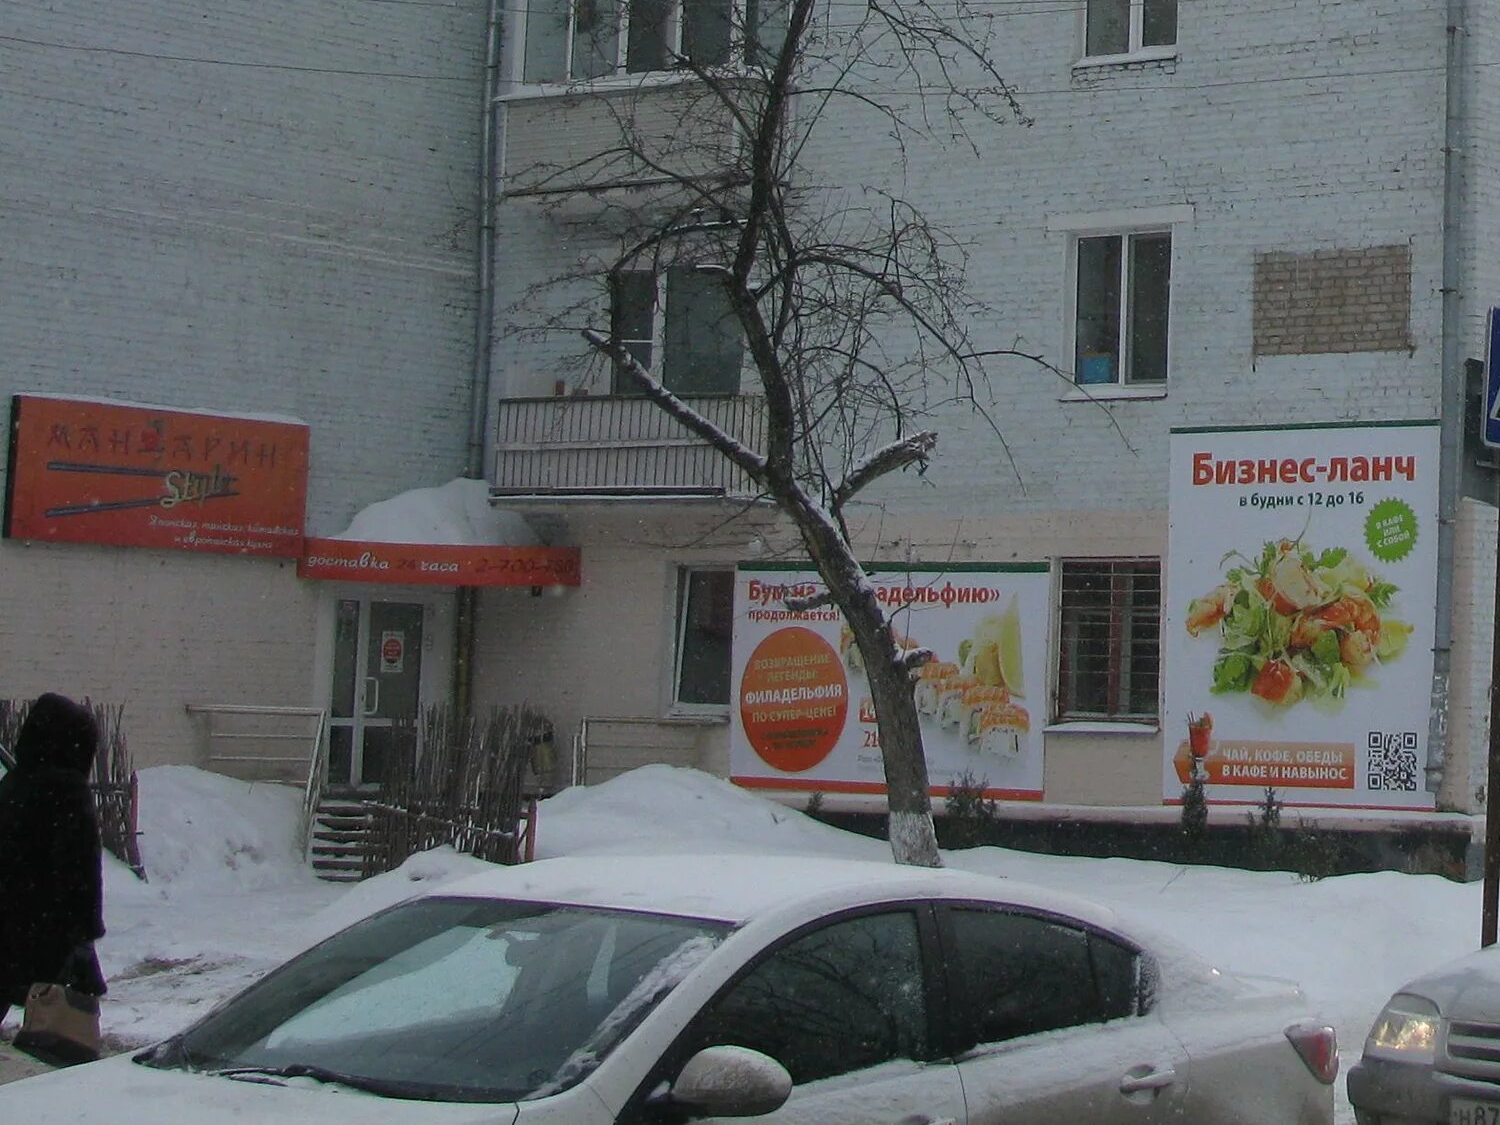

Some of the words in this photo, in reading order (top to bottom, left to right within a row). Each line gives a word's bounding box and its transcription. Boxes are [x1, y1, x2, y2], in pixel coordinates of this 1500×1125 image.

[1192, 452, 1415, 486] Бизнес-ланч
[1239, 494, 1248, 507] в
[1250, 492, 1294, 509] будни
[1296, 495, 1304, 506] с
[1309, 492, 1323, 506] 12
[1326, 493, 1345, 508] до
[1348, 490, 1365, 505] 16
[306, 551, 390, 571] доставка
[875, 580, 1000, 609] адельфию»
[748, 609, 840, 624] продолжается!
[754, 654, 831, 670] ВОЗВРАЩЕНИЕ
[745, 683, 843, 704] ФИЛАДЕЛЬФИЯ
[752, 711, 767, 723] ПО
[1296, 750, 1343, 765] ОБЕДЫ
[1222, 765, 1230, 776] В
[1233, 765, 1268, 777] КАФЕ
[1269, 766, 1279, 777] И
[1281, 767, 1349, 780] НАВЫНОС
